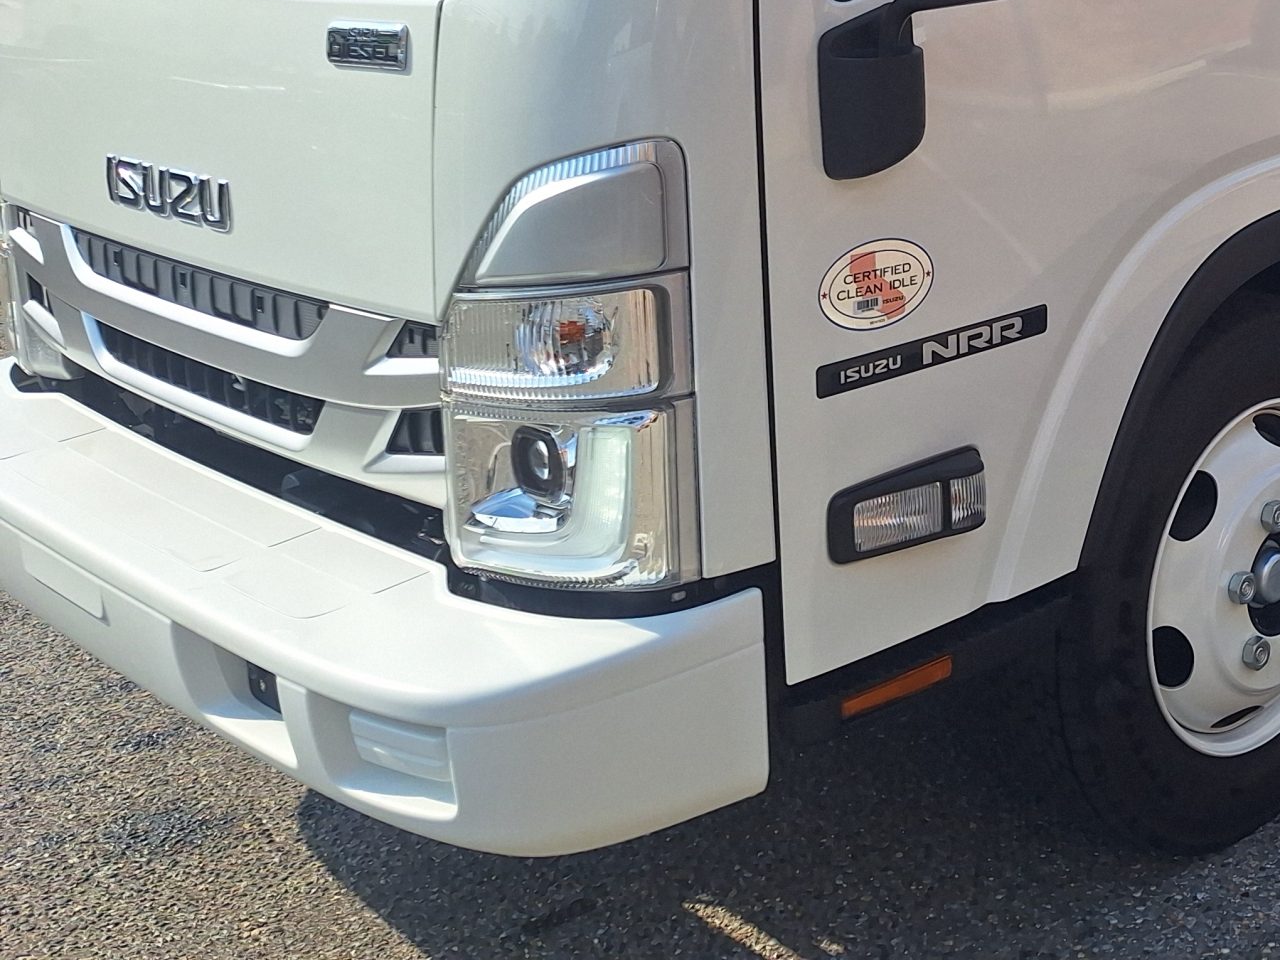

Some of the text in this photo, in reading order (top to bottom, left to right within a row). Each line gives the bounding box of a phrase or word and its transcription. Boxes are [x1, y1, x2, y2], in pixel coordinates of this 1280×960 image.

[328, 42, 399, 61] DIESEL
[106, 153, 231, 233] ISUZU
[843, 262, 912, 285] CERTIFIED
[836, 274, 918, 301] CLEAN IDLE
[882, 295, 904, 305] ISUZU
[840, 316, 1023, 384] ISUZU NRR
